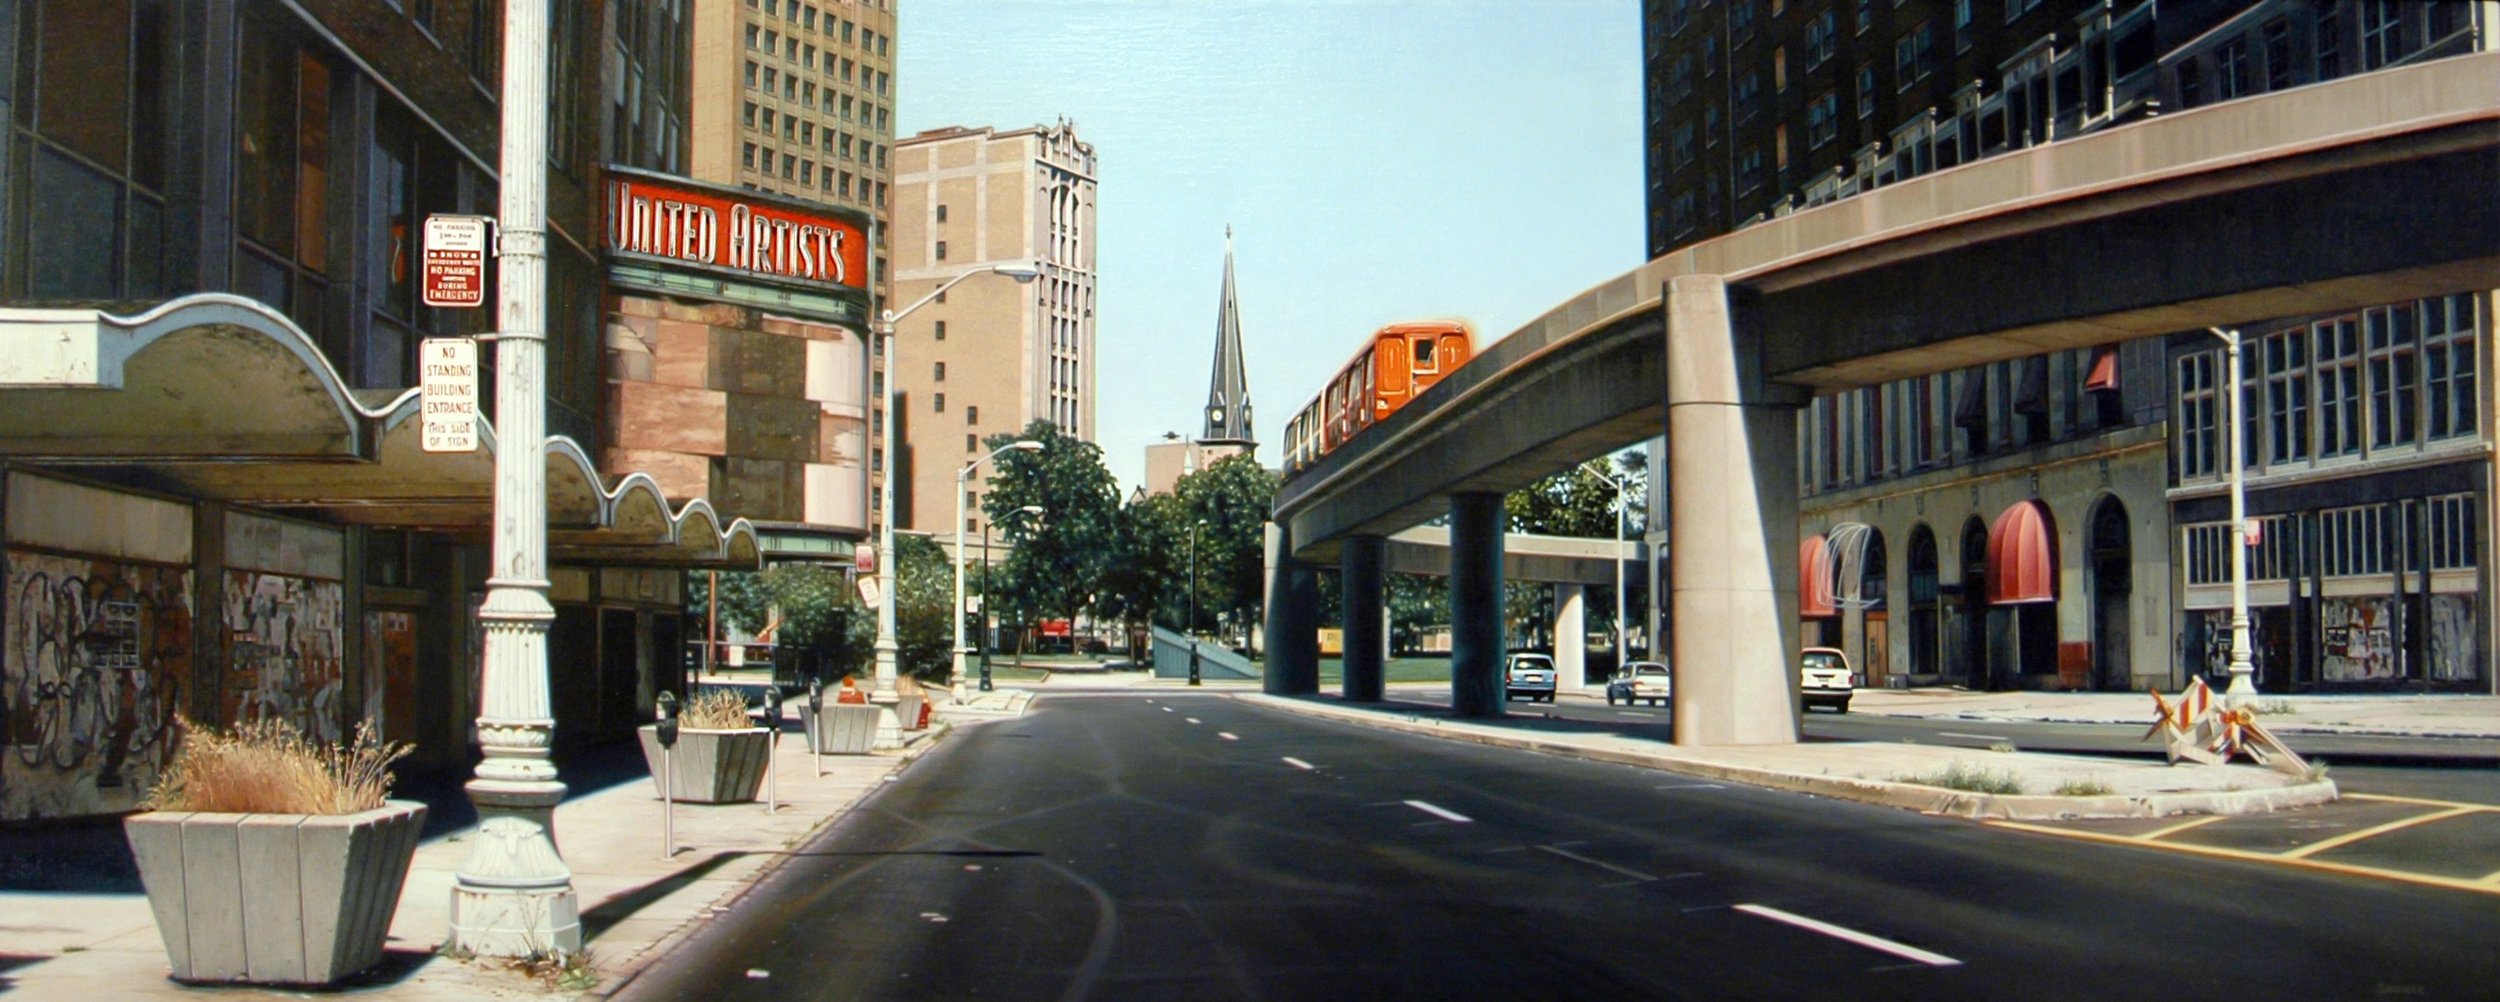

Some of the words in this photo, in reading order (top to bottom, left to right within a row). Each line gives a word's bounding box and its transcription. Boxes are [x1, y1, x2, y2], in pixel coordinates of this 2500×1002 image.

[608, 180, 717, 264] UNITED
[730, 203, 845, 283] ARTISTS
[430, 266, 443, 274] NO
[444, 266, 476, 276] PARKING
[429, 290, 478, 300] EMERGENCY
[442, 347, 455, 358] NO
[427, 364, 472, 376] STANDING
[427, 384, 471, 396] BUILDING
[428, 402, 472, 414] ENTRANCE
[428, 424, 446, 433] THIS
[451, 424, 470, 434] SIDE
[429, 437, 440, 446] OF
[448, 437, 469, 446] SIGN
